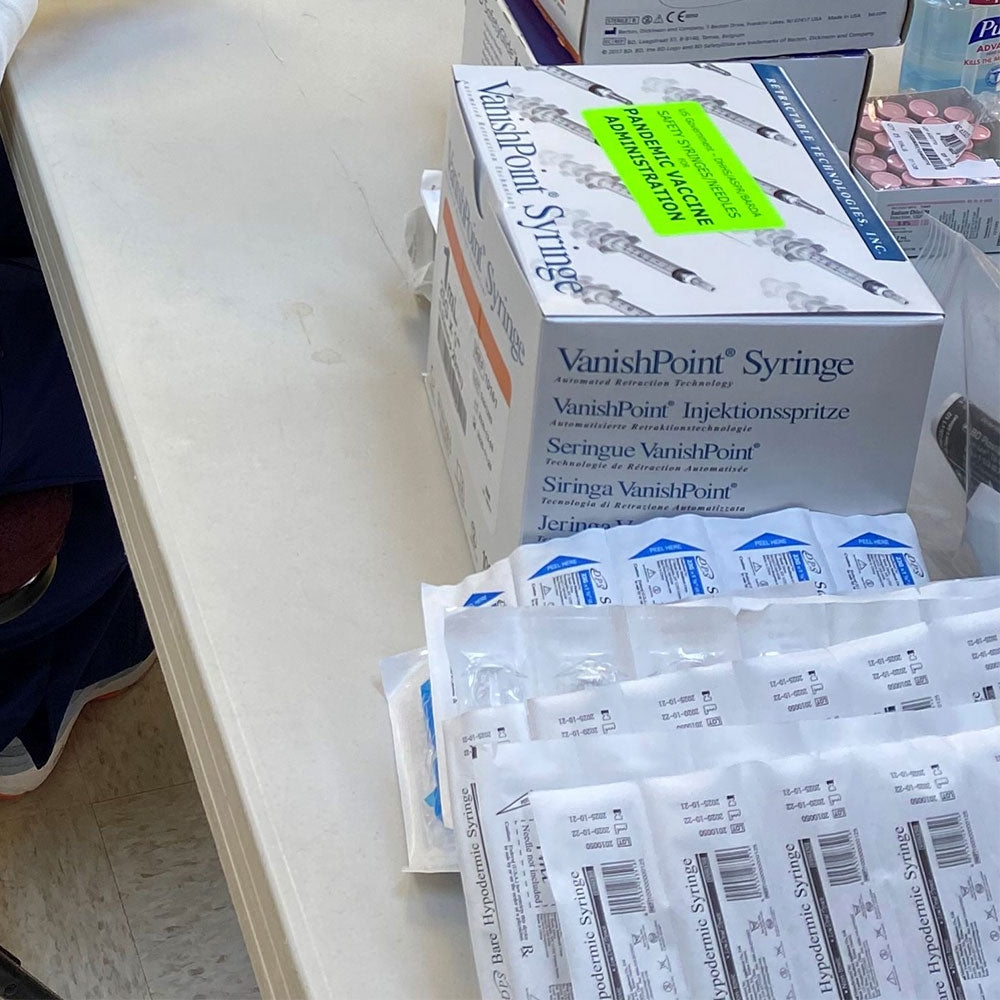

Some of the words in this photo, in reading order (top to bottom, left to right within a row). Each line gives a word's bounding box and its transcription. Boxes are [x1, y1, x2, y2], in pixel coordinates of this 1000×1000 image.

[685, 117, 715, 152] Government
[604, 115, 686, 222] ADMINISTRATION
[624, 107, 675, 168] PANDEMIC
[667, 170, 714, 226] VACCINE
[657, 110, 683, 138] SAFETY
[678, 139, 741, 219] SYRINGES/NEEDLES
[679, 157, 689, 168] FOR
[766, 76, 813, 142] RETRACTABLE
[865, 231, 887, 255] INC.
[517, 204, 584, 295] Syringe
[485, 260, 526, 366] Syringe
[554, 376, 611, 386] Automated
[615, 378, 670, 387] Retraction
[675, 380, 734, 388] Technology
[743, 349, 854, 383] Syringe
[549, 419, 627, 430] Automatisierte
[631, 423, 752, 433] Retraktionstechnologie
[683, 401, 850, 424] Injektionsspritze
[545, 458, 608, 470] Technologie
[611, 462, 623, 470] de
[547, 437, 636, 461] Seringue
[541, 497, 596, 508] Tecnologia
[614, 502, 669, 511] Retrazione
[673, 504, 746, 512] Automatizzata
[542, 476, 613, 499] Siringa
[650, 545, 663, 553] PEEL
[754, 539, 770, 547] PEEL
[461, 787, 479, 838] Syringe
[522, 824, 533, 851] Needle
[895, 826, 919, 881] Syringe
[526, 852, 534, 867] not
[785, 843, 809, 899] Syringe
[471, 844, 494, 926] Hypodermic
[529, 869, 541, 904] included
[571, 871, 593, 926] Syringe
[683, 858, 706, 913] Syringe
[909, 886, 941, 974] Hypodermic
[489, 932, 504, 965] Bare
[698, 919, 725, 1000] ypodermic
[799, 903, 833, 994] Hypodermic
